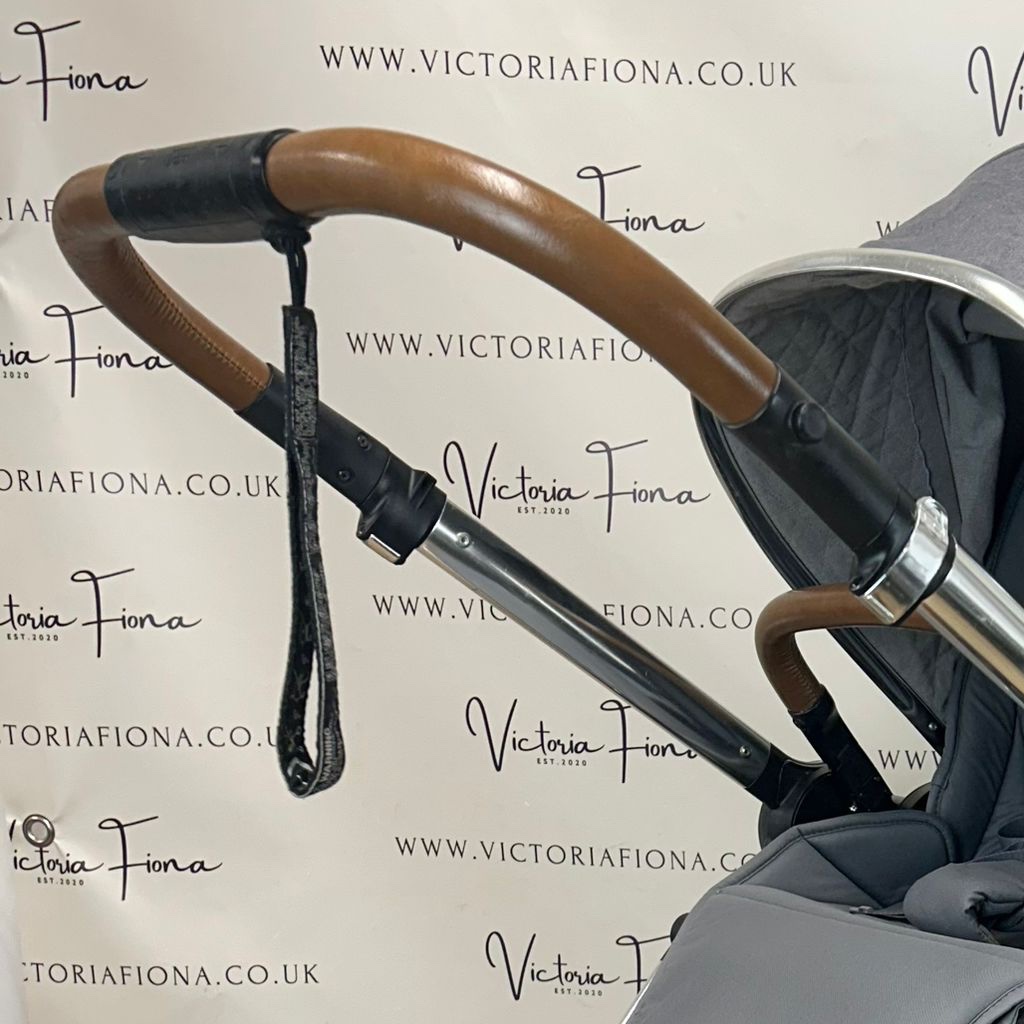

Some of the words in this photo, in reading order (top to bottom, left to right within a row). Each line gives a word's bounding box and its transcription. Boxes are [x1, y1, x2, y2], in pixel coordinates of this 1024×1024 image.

[14, 20, 148, 122] Fiona
[319, 45, 798, 87] WWW.VICTORIAFIONA.CO.UK
[346, 332, 655, 363] WWW.VICTORIAFIO
[443, 441, 590, 518] Victoria
[585, 440, 711, 533] Fiona
[517, 506, 570, 515] EST.2020
[0, 594, 77, 630] toria
[70, 568, 202, 658] Fiona
[7, 633, 59, 641] EST.2020
[466, 697, 605, 772] Victoria
[537, 758, 587, 766] EST.2020
[9, 819, 104, 875] ictoria
[98, 816, 223, 901] Fiona
[22, 962, 319, 986] TORIAFIONA.CO.UK
[485, 931, 620, 1001] Victoria
